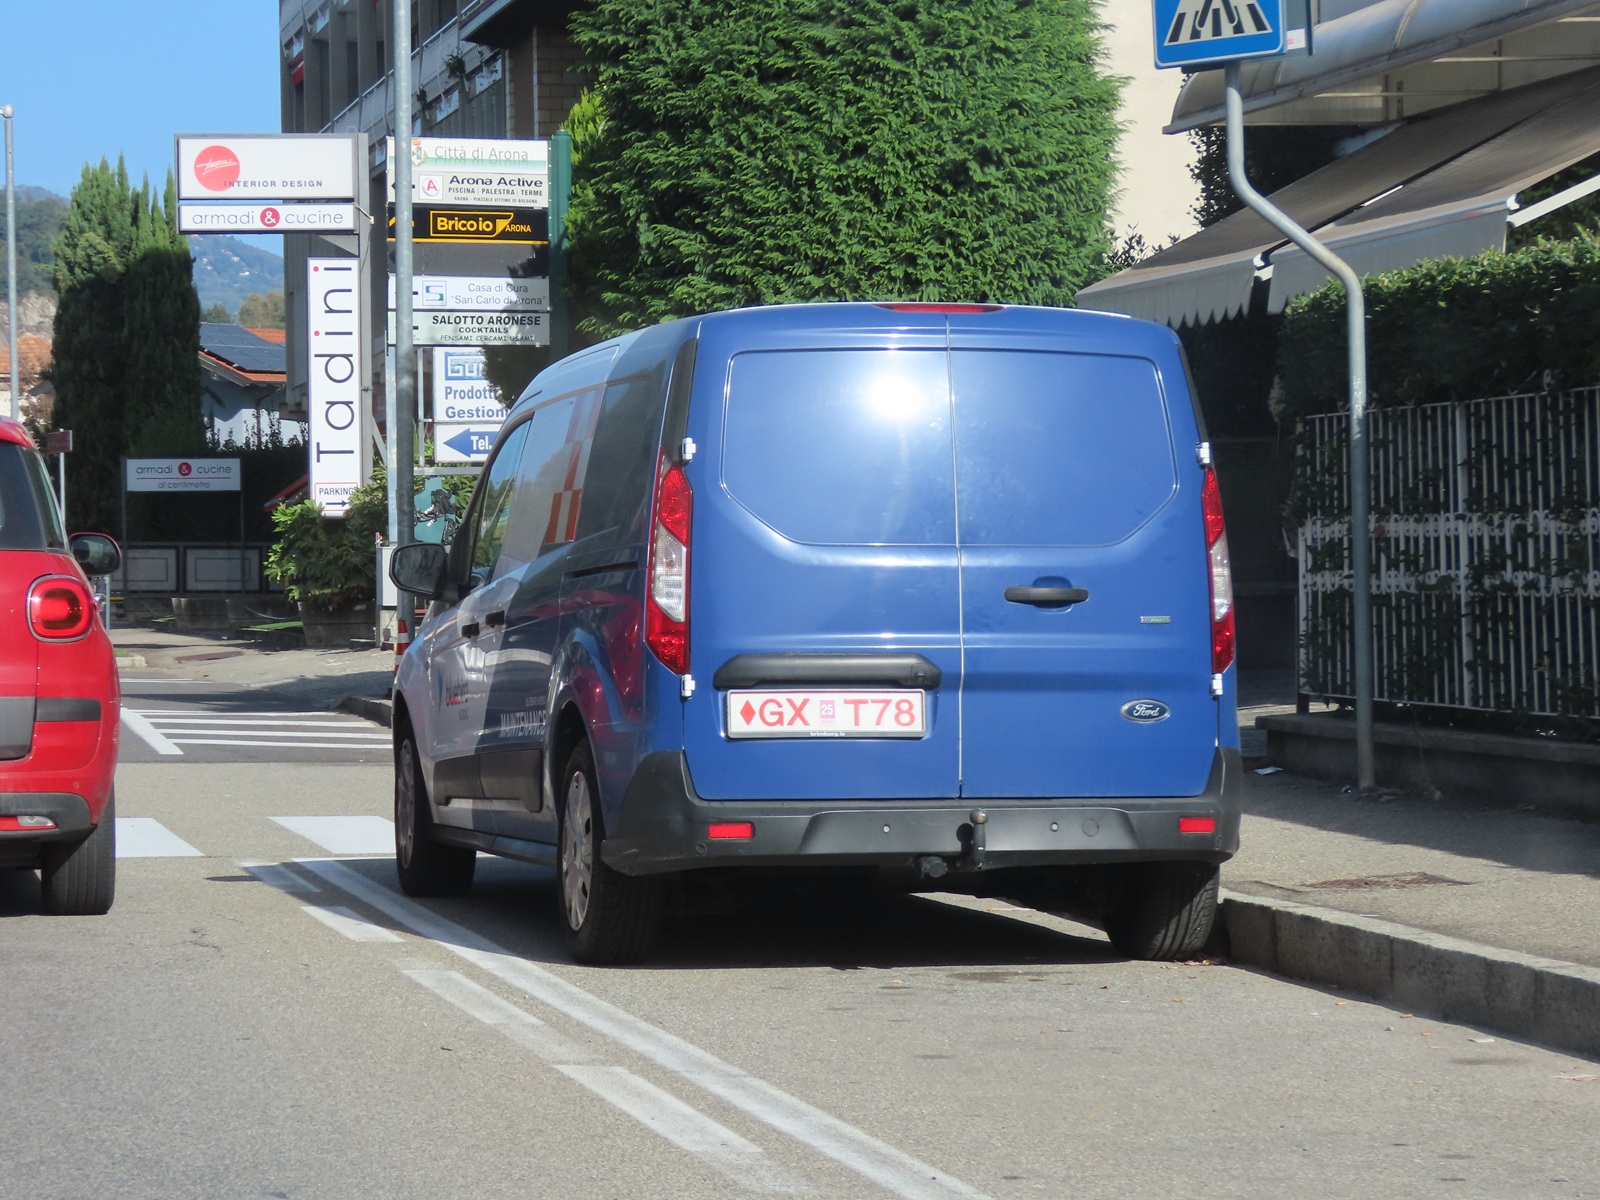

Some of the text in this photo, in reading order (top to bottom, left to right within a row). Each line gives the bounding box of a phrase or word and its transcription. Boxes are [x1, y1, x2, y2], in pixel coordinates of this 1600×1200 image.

[434, 145, 529, 161] Città di Arona
[223, 180, 323, 188] INTERIOR DESIGN
[449, 175, 543, 188] Arona Active
[481, 188, 515, 196] PALESTRA
[520, 189, 543, 197] TERME
[192, 210, 344, 225] armadi & cucine
[505, 224, 532, 233] ARONA
[468, 282, 529, 293] Casa di Cura
[475, 295, 501, 305] Carlo
[504, 295, 513, 306] di
[432, 315, 541, 326] SALOTTO ARONESE
[458, 326, 509, 334] COCKTAILS
[314, 266, 355, 464] Tadini
[471, 436, 492, 450] Tel.
[136, 464, 232, 474] armadi & cucine
[158, 481, 211, 489] al centimetro
[319, 487, 354, 496] PARKING
[758, 698, 916, 727] GX 25 T78
[1133, 703, 1160, 717] Ford
